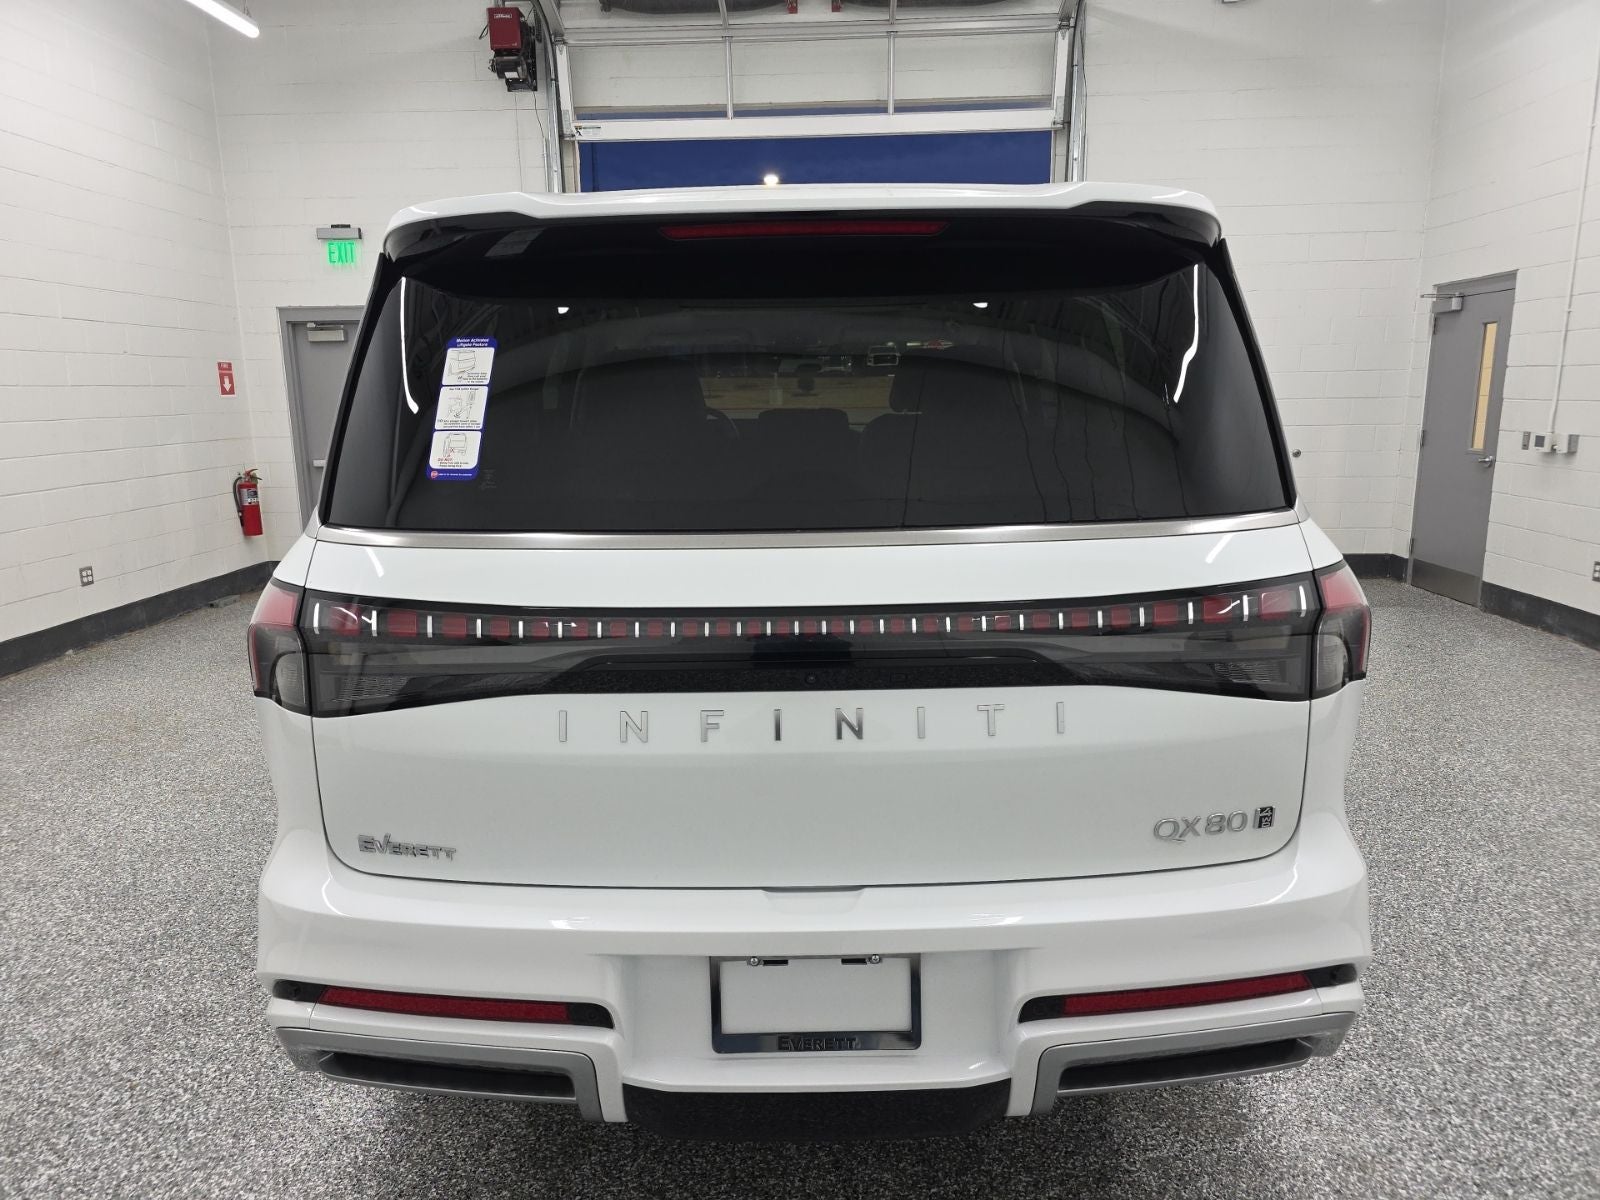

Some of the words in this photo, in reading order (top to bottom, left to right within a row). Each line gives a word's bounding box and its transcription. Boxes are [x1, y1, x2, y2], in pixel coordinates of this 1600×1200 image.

[328, 242, 354, 264] EXIT
[558, 701, 1065, 743] INFINITI
[1153, 811, 1248, 842] QX80
[358, 833, 457, 861] EVERETT
[778, 1035, 858, 1051] EVERETT
